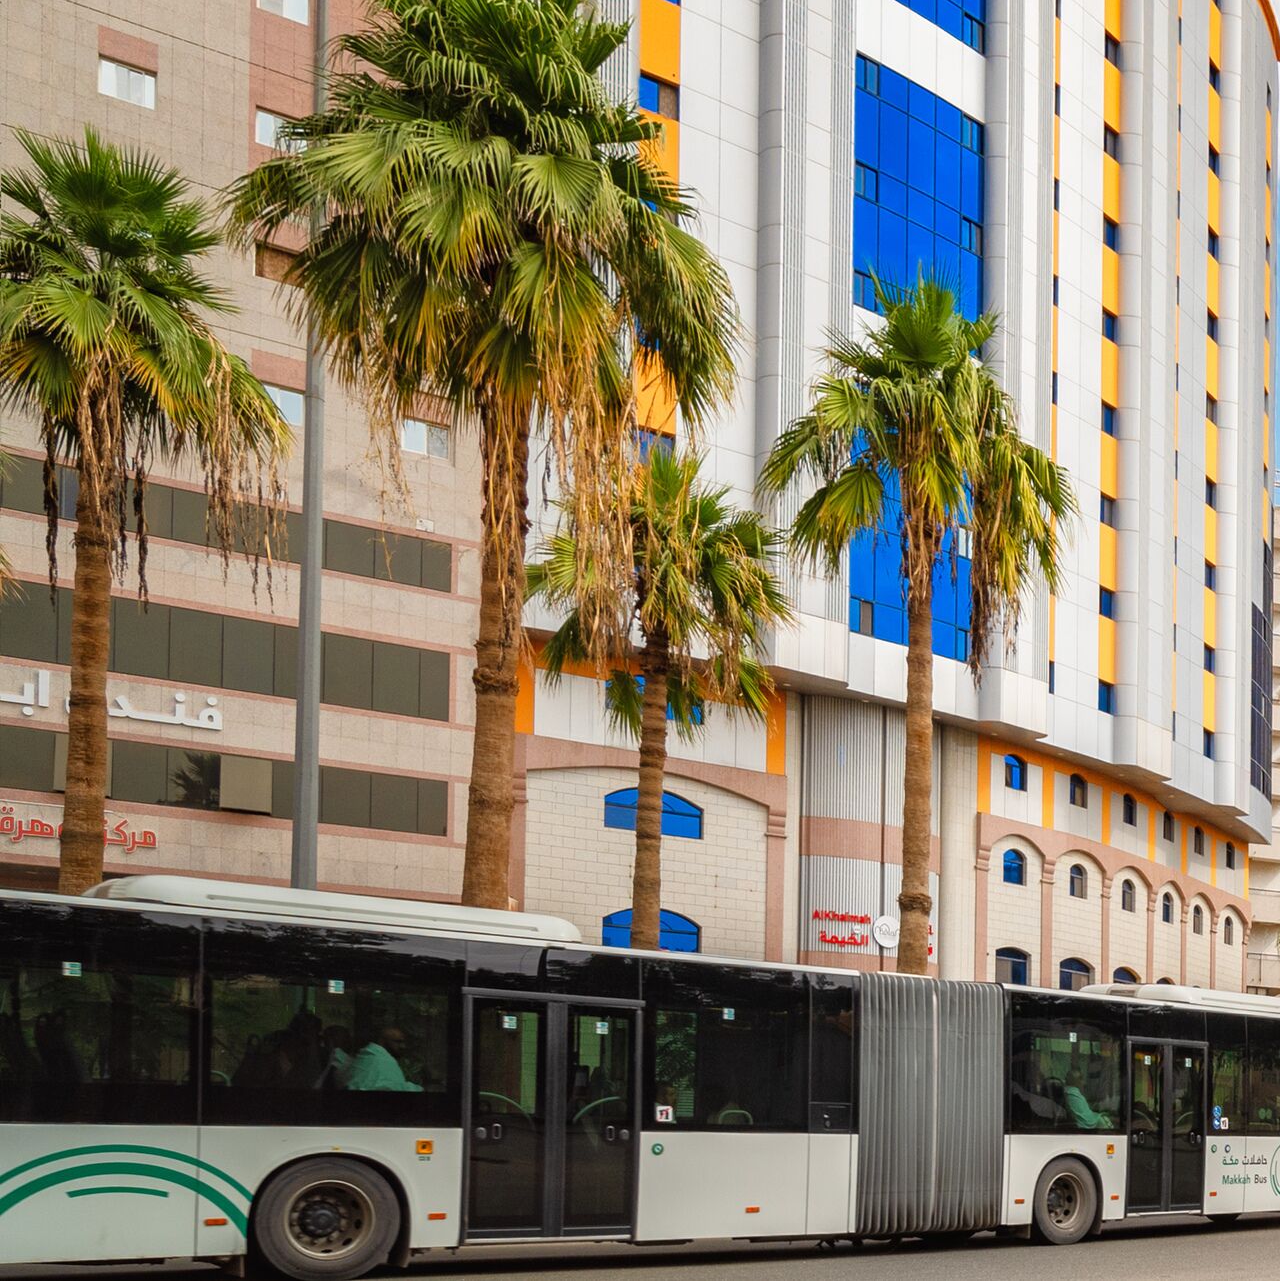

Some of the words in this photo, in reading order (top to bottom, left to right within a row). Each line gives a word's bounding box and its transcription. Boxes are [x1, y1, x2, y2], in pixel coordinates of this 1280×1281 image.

[66, 692, 223, 730] فند
[1222, 1155, 1239, 1166] مكة
[1242, 1154, 1267, 1165] حافلات
[1222, 1174, 1251, 1185] Makkah
[1254, 1174, 1267, 1184] Bus
